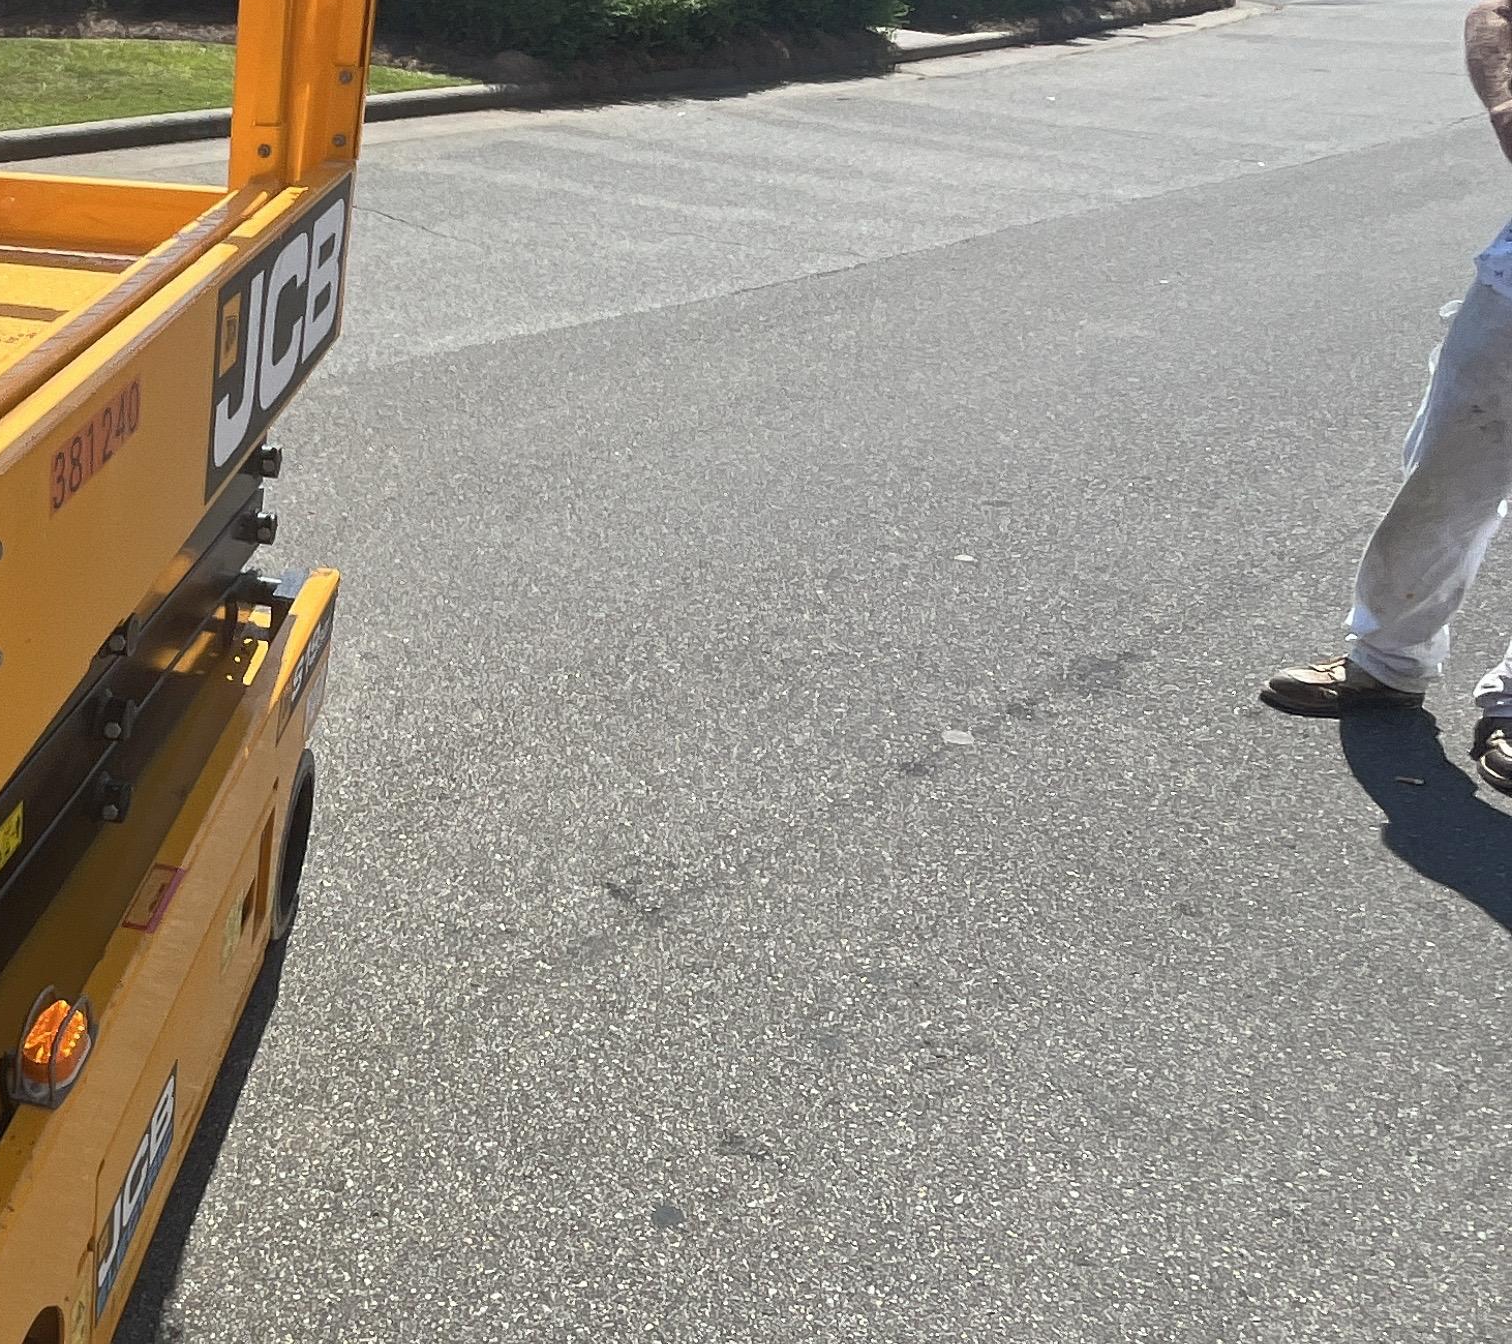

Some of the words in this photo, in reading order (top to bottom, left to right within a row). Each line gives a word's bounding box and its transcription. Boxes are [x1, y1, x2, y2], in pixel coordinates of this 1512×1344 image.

[213, 198, 346, 469] JCB
[52, 380, 140, 509] 381240
[98, 1074, 176, 1289] JCB
